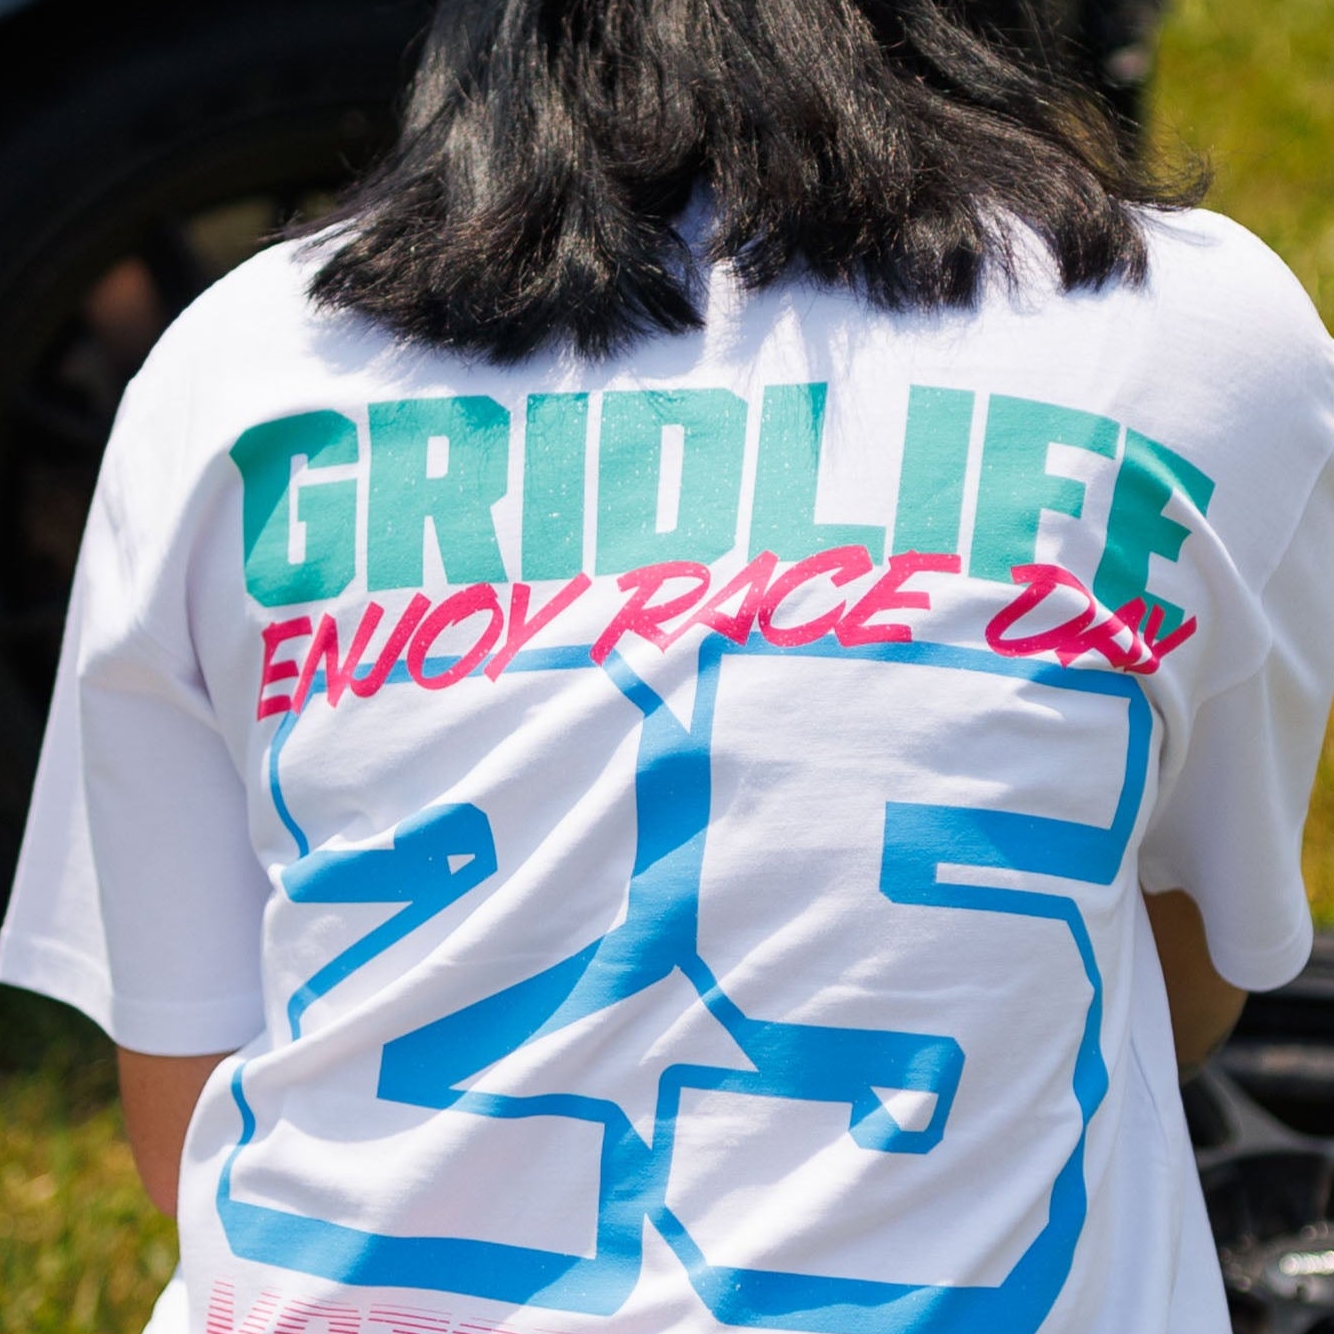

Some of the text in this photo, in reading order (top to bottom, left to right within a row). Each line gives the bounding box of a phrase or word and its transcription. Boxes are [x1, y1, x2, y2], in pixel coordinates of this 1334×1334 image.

[229, 381, 1216, 641] GRIDLIFE
[257, 544, 1198, 722] ENJOY RACE DAY
